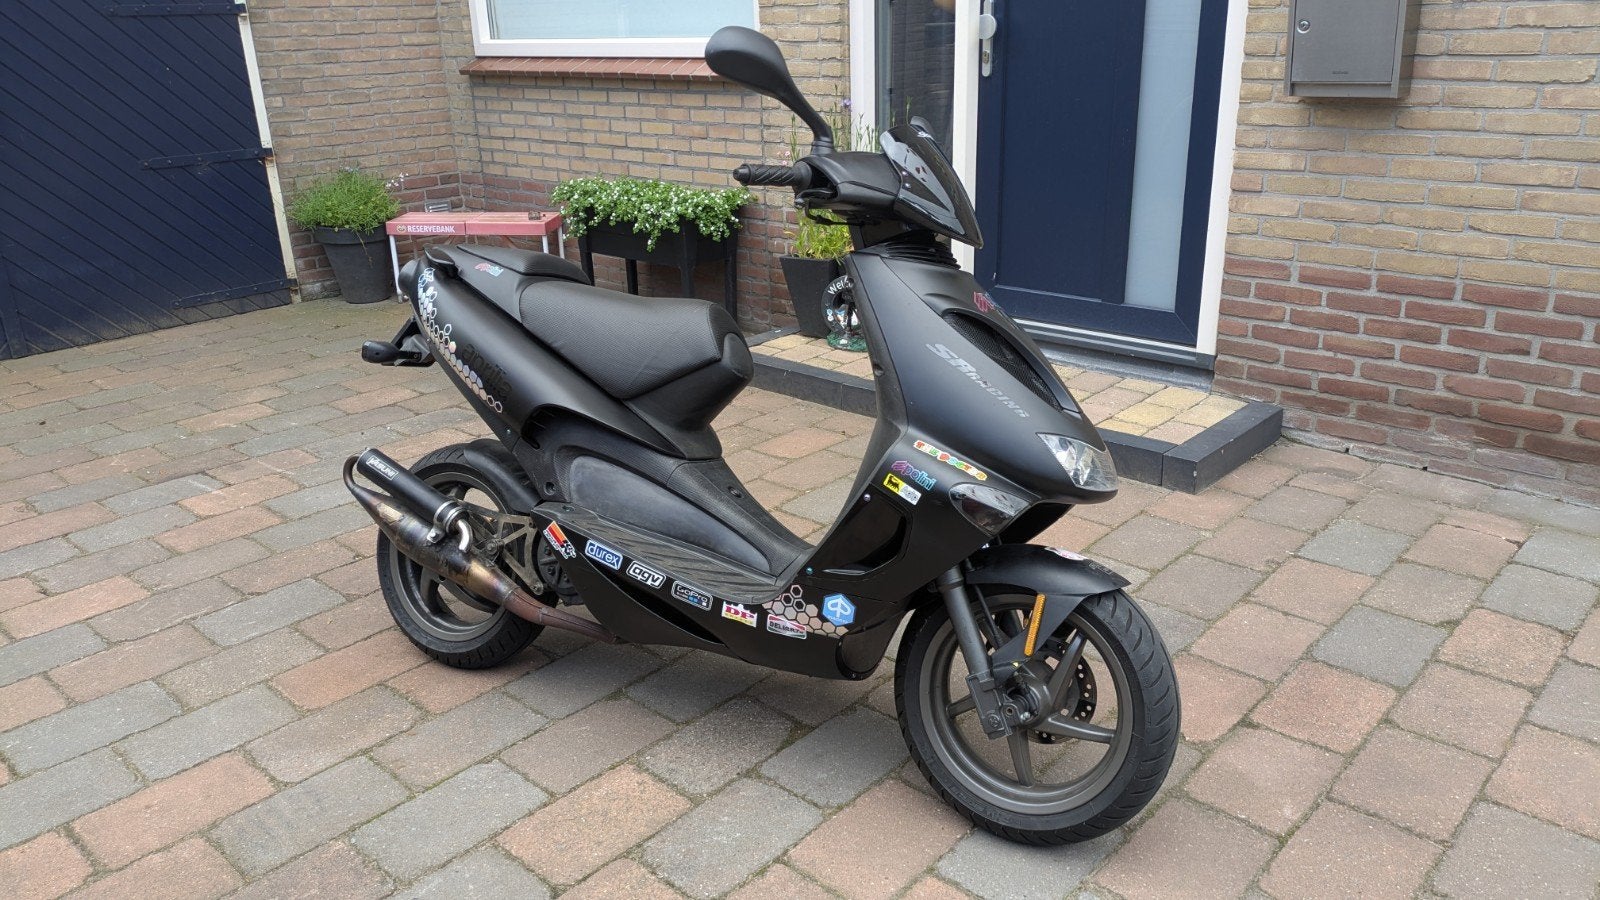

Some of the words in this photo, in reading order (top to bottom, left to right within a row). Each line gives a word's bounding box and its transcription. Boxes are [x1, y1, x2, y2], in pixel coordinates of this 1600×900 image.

[407, 225, 456, 233] RESERVEBANK
[901, 462, 937, 491] polini
[588, 543, 619, 568] durex
[632, 566, 660, 584] agv
[677, 585, 708, 603] GoPro
